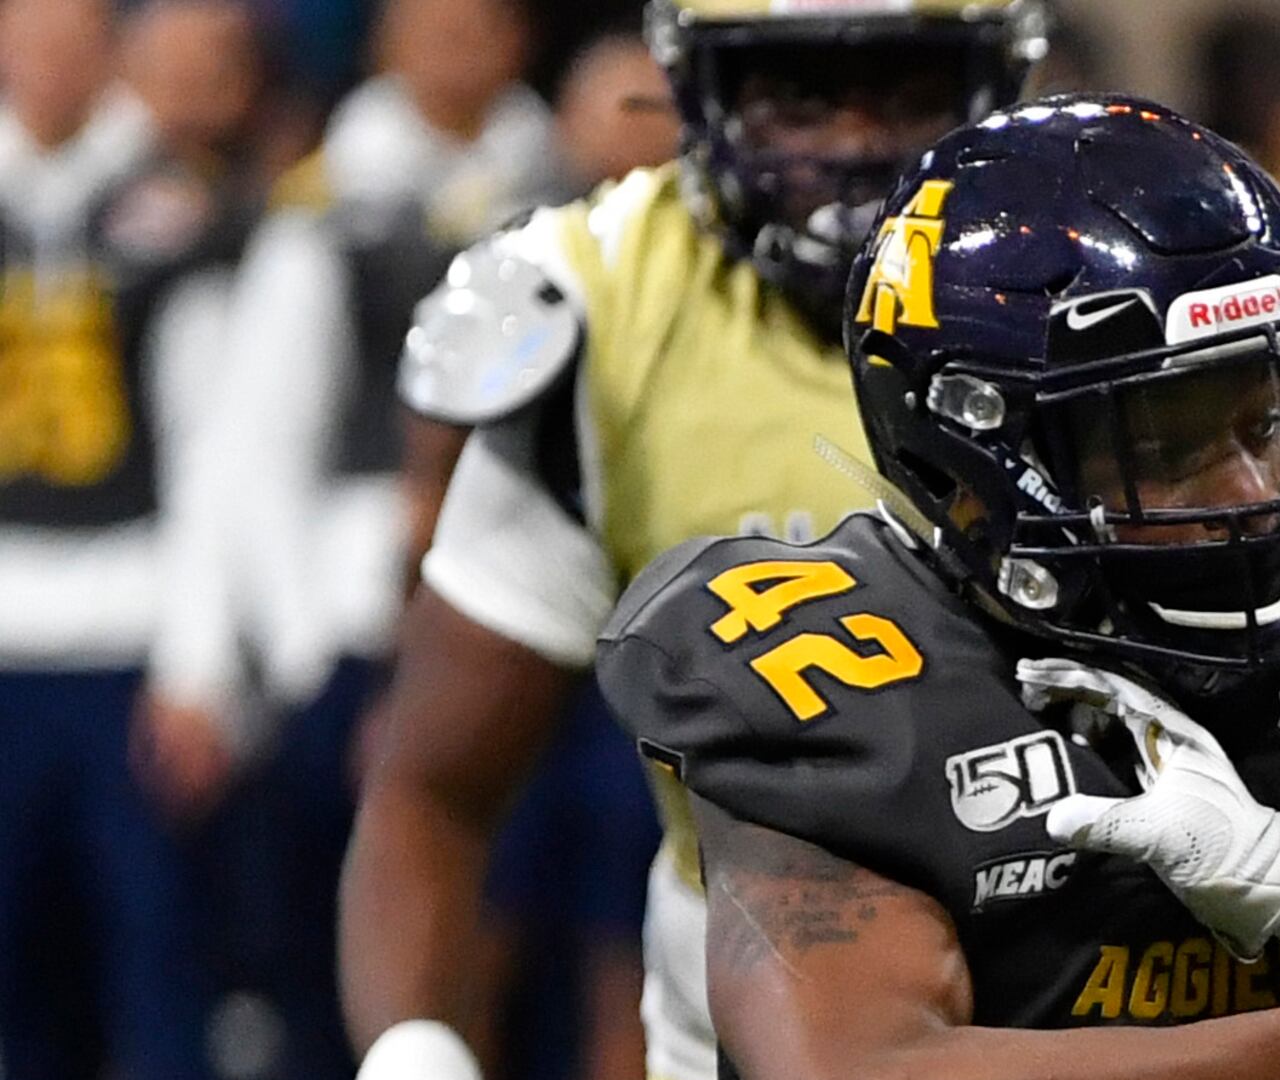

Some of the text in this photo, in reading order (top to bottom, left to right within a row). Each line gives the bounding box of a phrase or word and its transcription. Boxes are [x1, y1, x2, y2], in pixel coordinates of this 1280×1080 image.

[706, 560, 924, 721] 42
[945, 729, 1077, 832] 150
[972, 852, 1078, 907] MEAC
